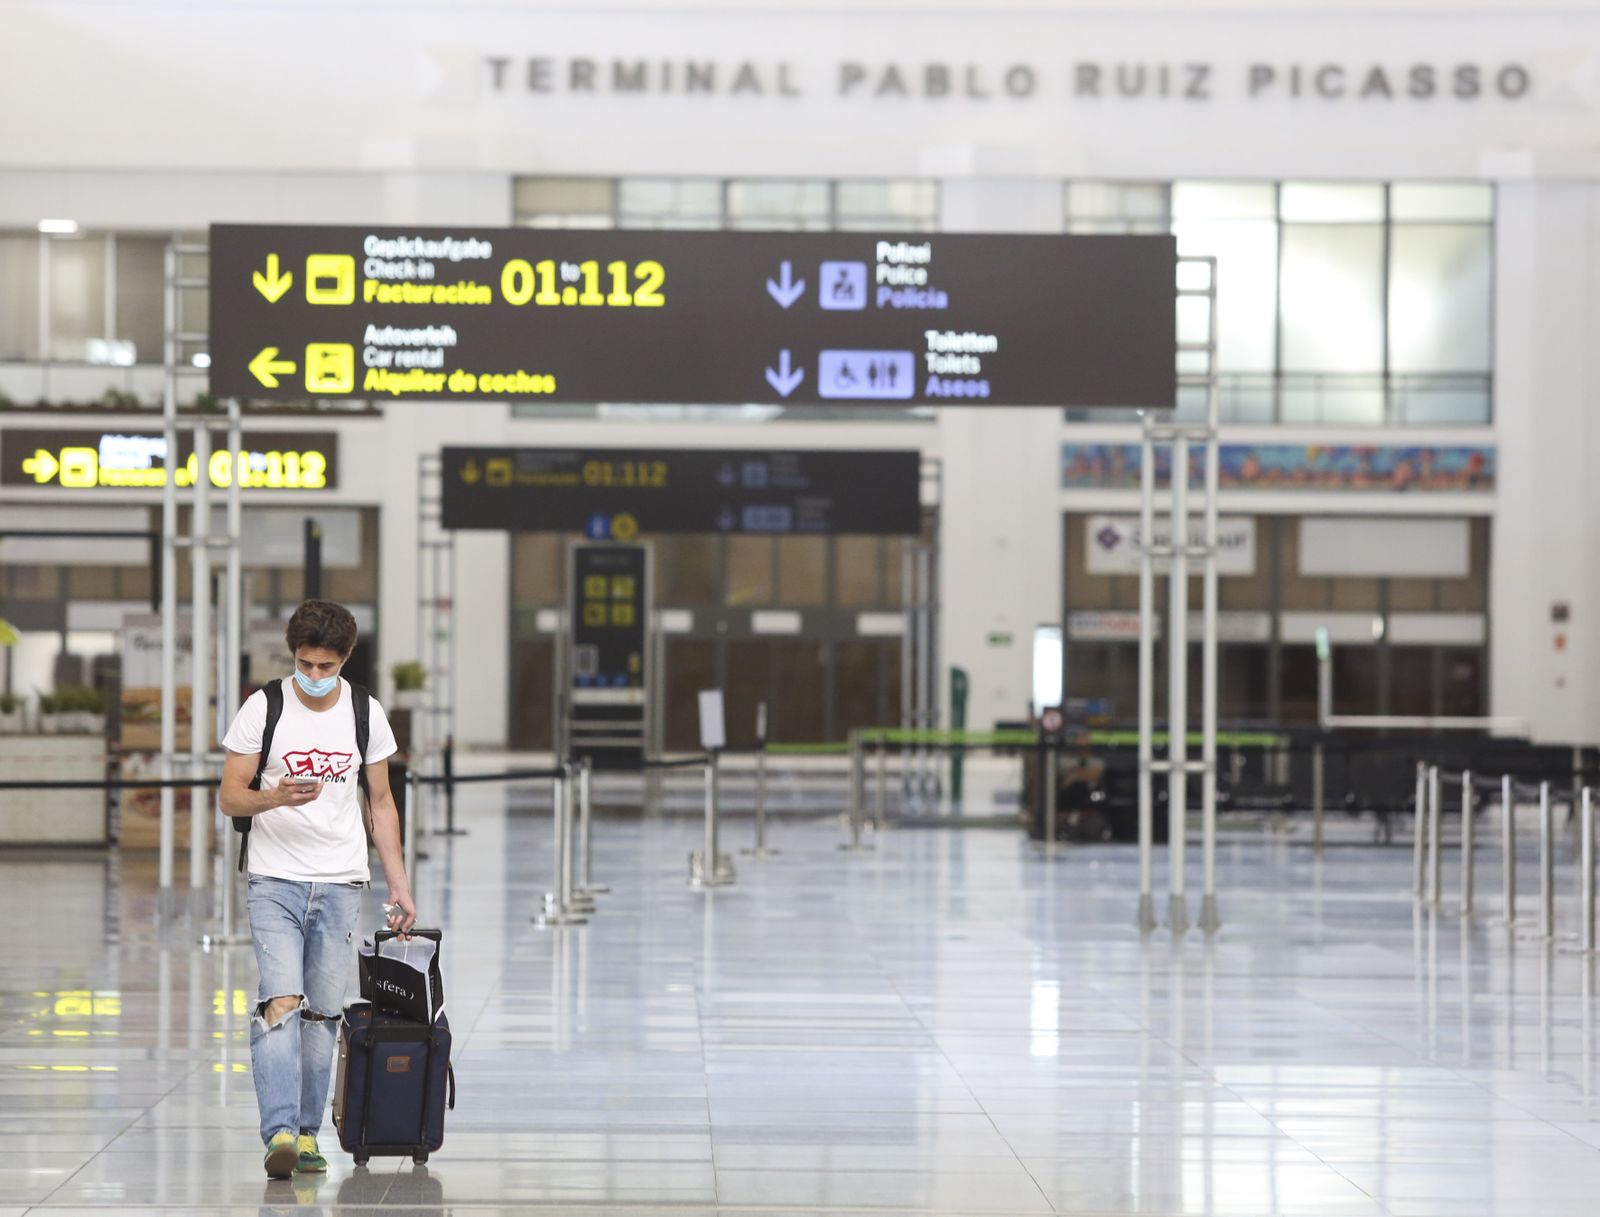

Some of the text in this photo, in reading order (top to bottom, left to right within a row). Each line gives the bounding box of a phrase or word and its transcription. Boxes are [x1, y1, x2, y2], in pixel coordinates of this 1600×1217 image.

[488, 57, 1532, 101] TERMINAL PABLO RUIZ PICASSO
[876, 264, 927, 285] Police
[363, 346, 444, 368] Car rental
[925, 352, 981, 374] Toilets
[364, 368, 556, 396] Alquiler de coches
[925, 374, 990, 398] Aseos
